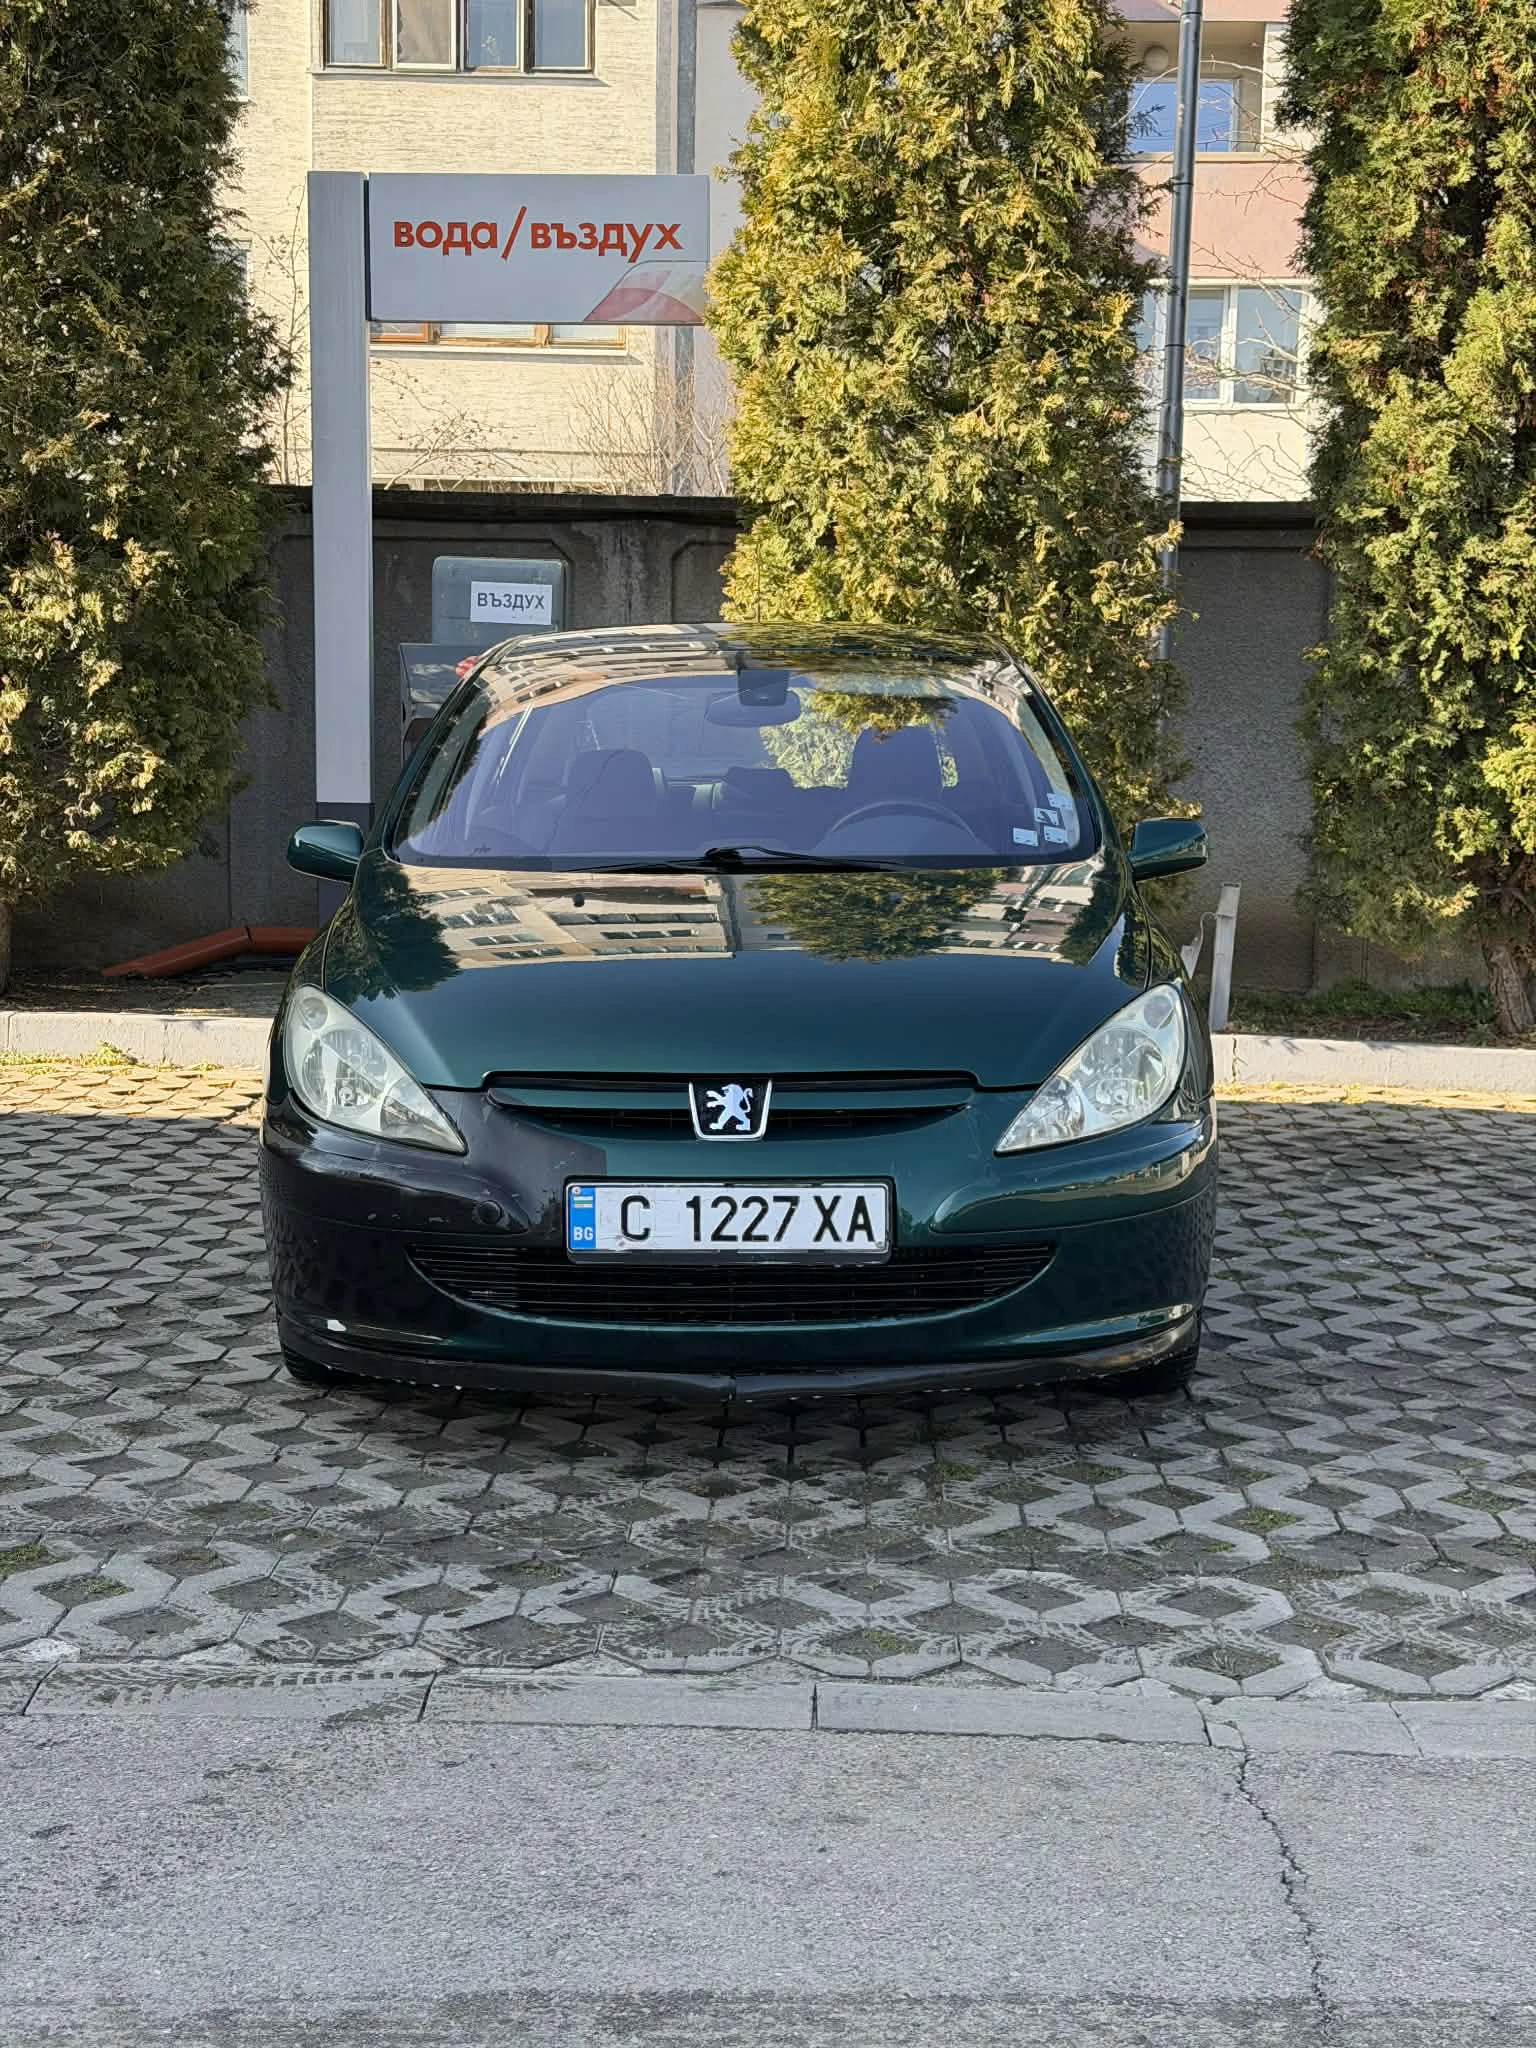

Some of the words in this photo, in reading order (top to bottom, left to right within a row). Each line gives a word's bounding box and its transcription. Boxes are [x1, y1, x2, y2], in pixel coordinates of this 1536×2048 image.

[477, 592, 545, 612] ВЪЗДУХ
[685, 1195, 801, 1242] 1227
[573, 1226, 594, 1241] BG
